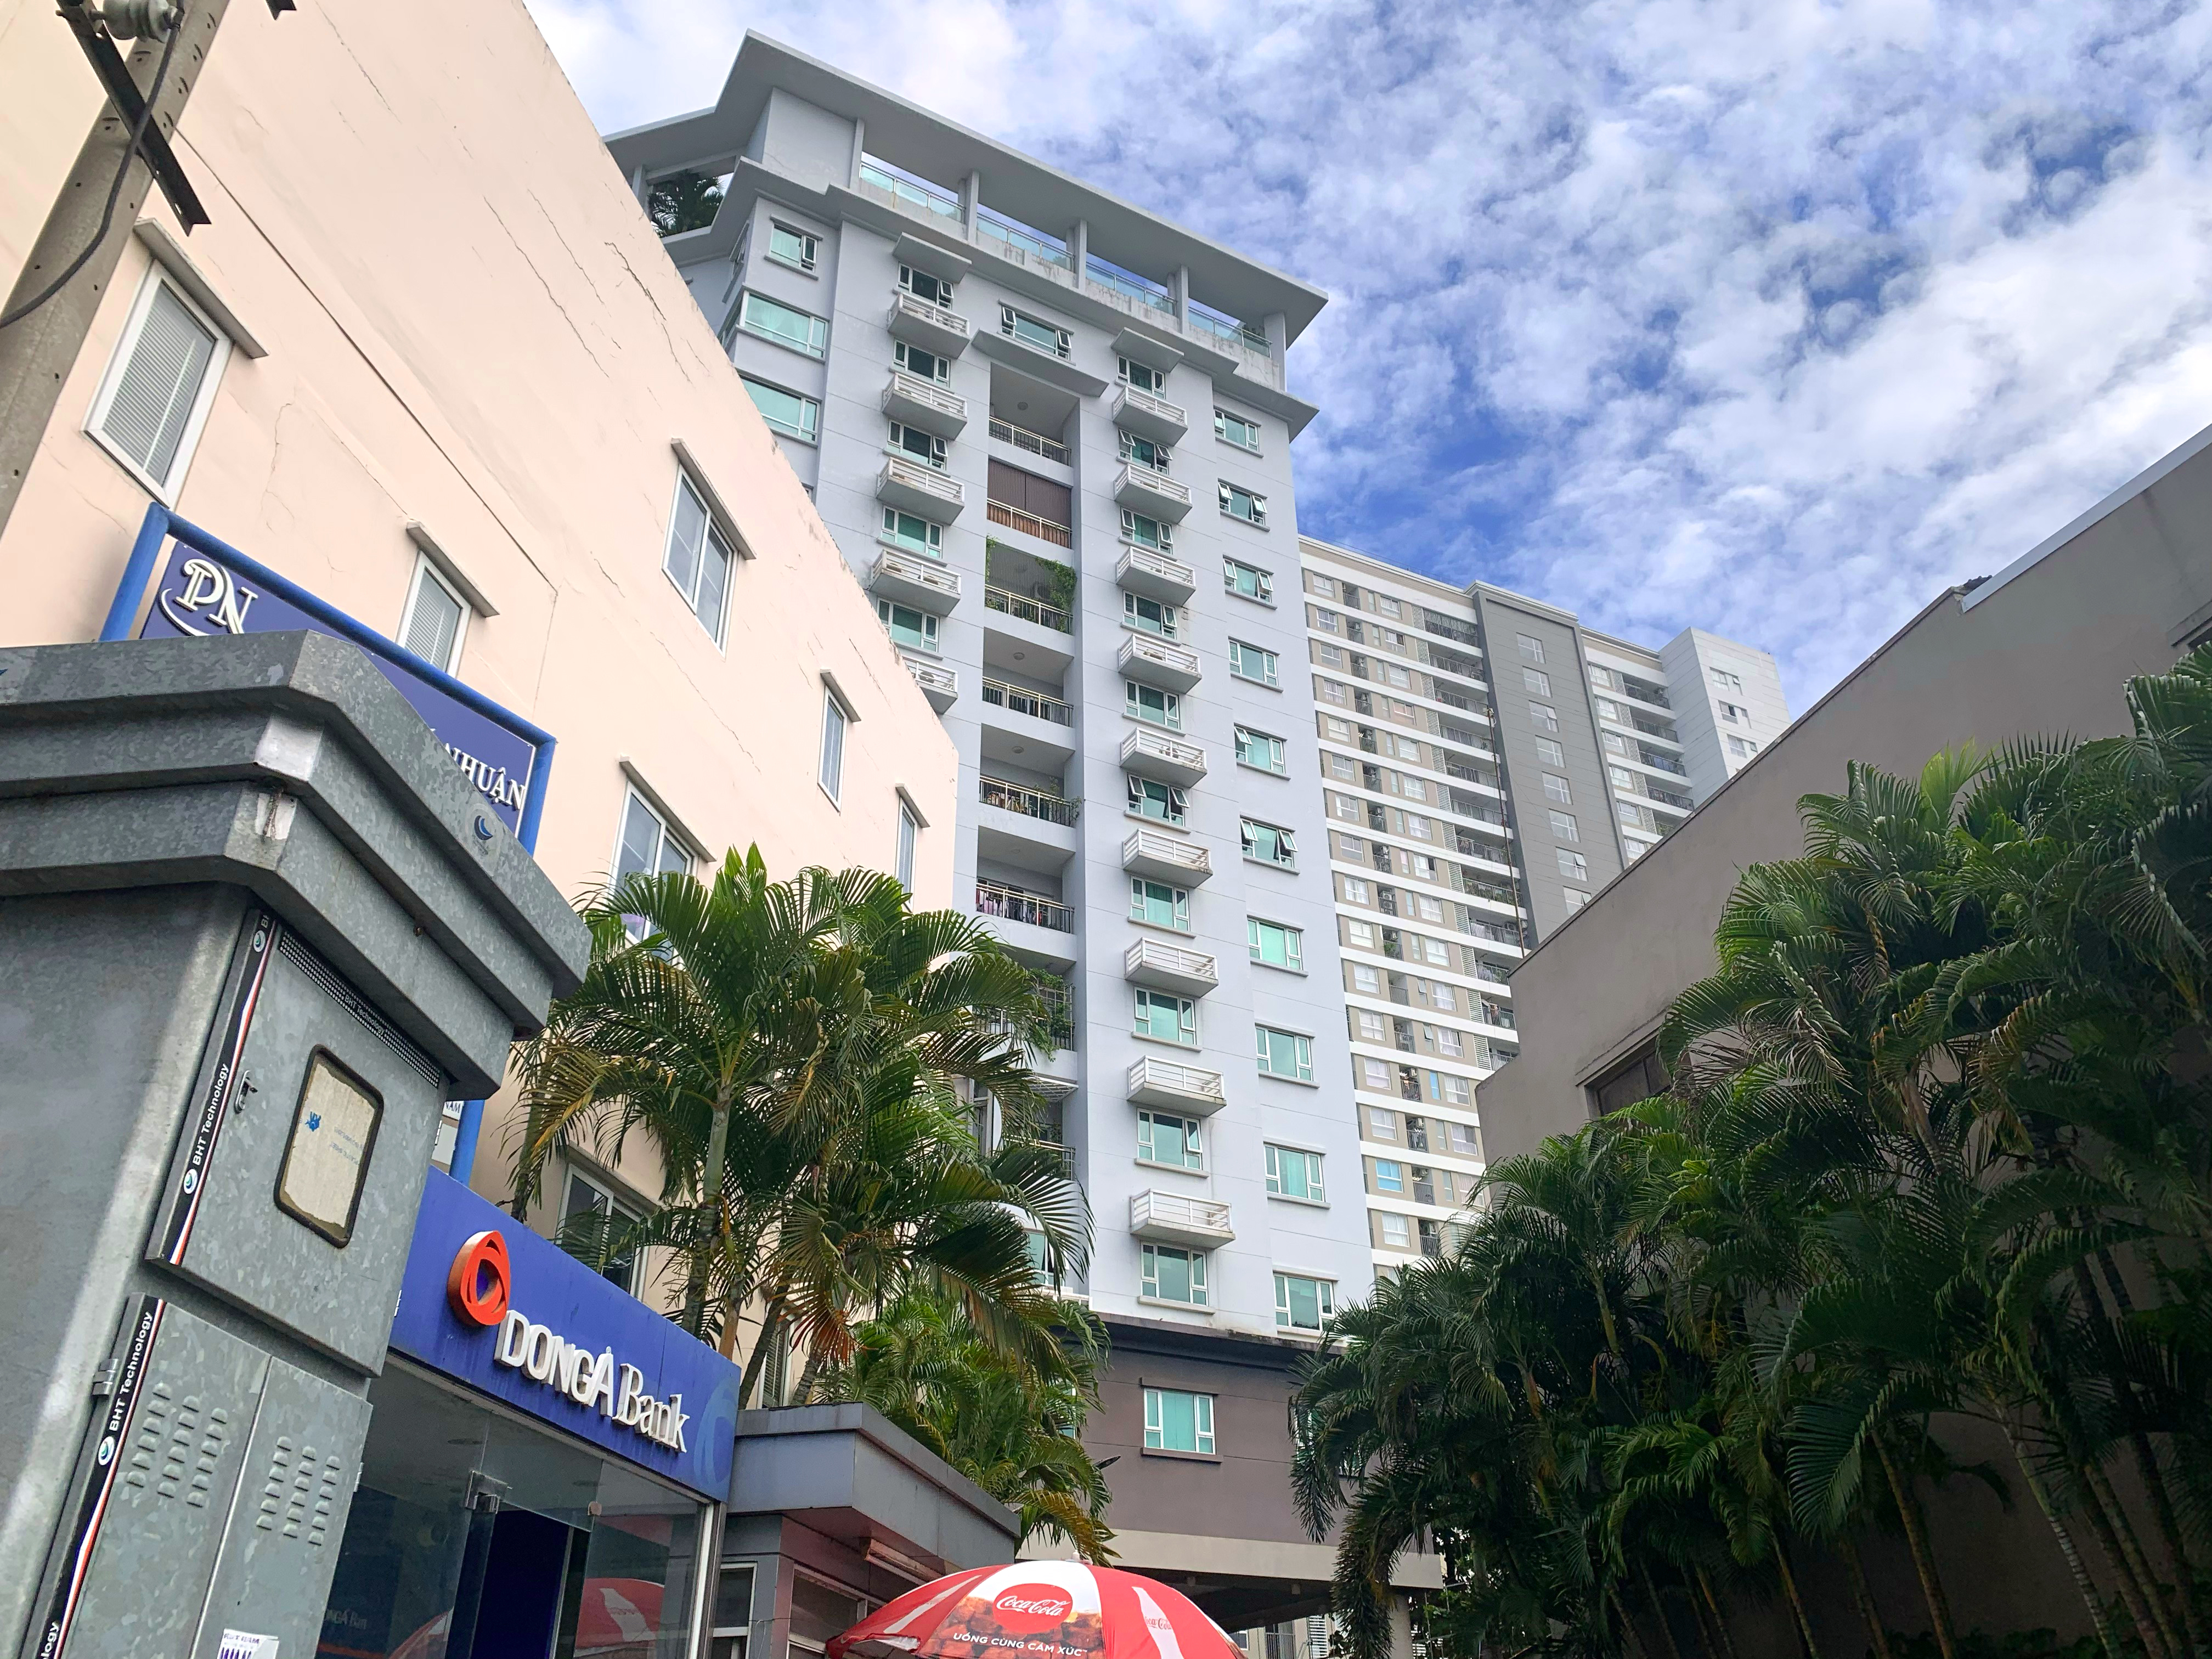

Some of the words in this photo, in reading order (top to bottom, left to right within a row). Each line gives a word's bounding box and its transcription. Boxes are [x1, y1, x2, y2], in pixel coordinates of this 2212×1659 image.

[345, 994, 357, 1009] BHT
[357, 1005, 385, 1035] Technology
[192, 1136, 207, 1166] BHT
[201, 1063, 230, 1128] Technology
[109, 1397, 126, 1431] BHT
[119, 1311, 153, 1394] Technology
[612, 1363, 690, 1453] Bank
[996, 1595, 1071, 1616] Coca-Cola
